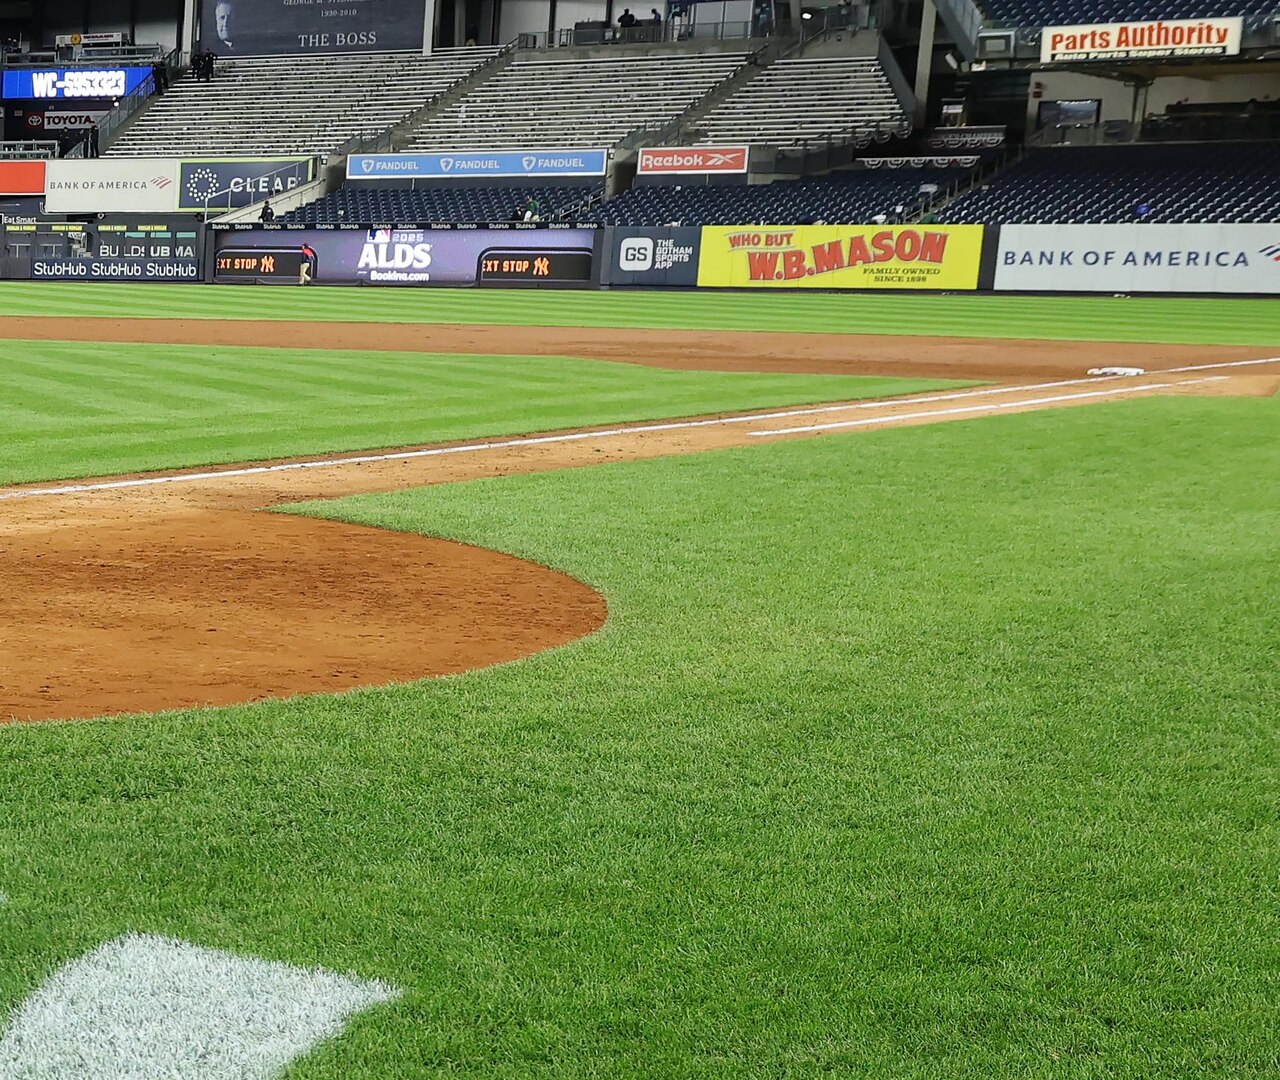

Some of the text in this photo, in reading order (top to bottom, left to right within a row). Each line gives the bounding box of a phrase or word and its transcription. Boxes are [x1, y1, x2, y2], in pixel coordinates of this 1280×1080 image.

[298, 31, 377, 47] THE BOSS
[1051, 22, 1229, 52] Parts Authority
[45, 115, 96, 125] TOYOTA
[375, 161, 419, 171] FANDUEL
[455, 159, 500, 169] FANDUEL
[538, 157, 585, 168] FANDUEL
[642, 154, 703, 168] Reebok
[50, 180, 148, 190] BANK OF AMERICA
[392, 233, 424, 242] 2025
[657, 239, 675, 247] THE
[728, 233, 793, 248] WHO BUT
[357, 243, 433, 268] ALDS
[625, 247, 648, 261] GS
[656, 246, 693, 254] GOTHAM
[234, 258, 257, 269] STOP
[655, 254, 689, 262] SPORTS
[1004, 250, 1250, 267] BANK OF AMERICA
[34, 262, 87, 276] StubHub
[91, 262, 141, 276] StubHub
[146, 262, 197, 277] StubHub
[503, 260, 529, 272] STOP
[654, 261, 673, 269] APP
[370, 270, 429, 282] Booking.com
[863, 267, 940, 275] FAMILY OWNED
[874, 275, 904, 283] SINCE
